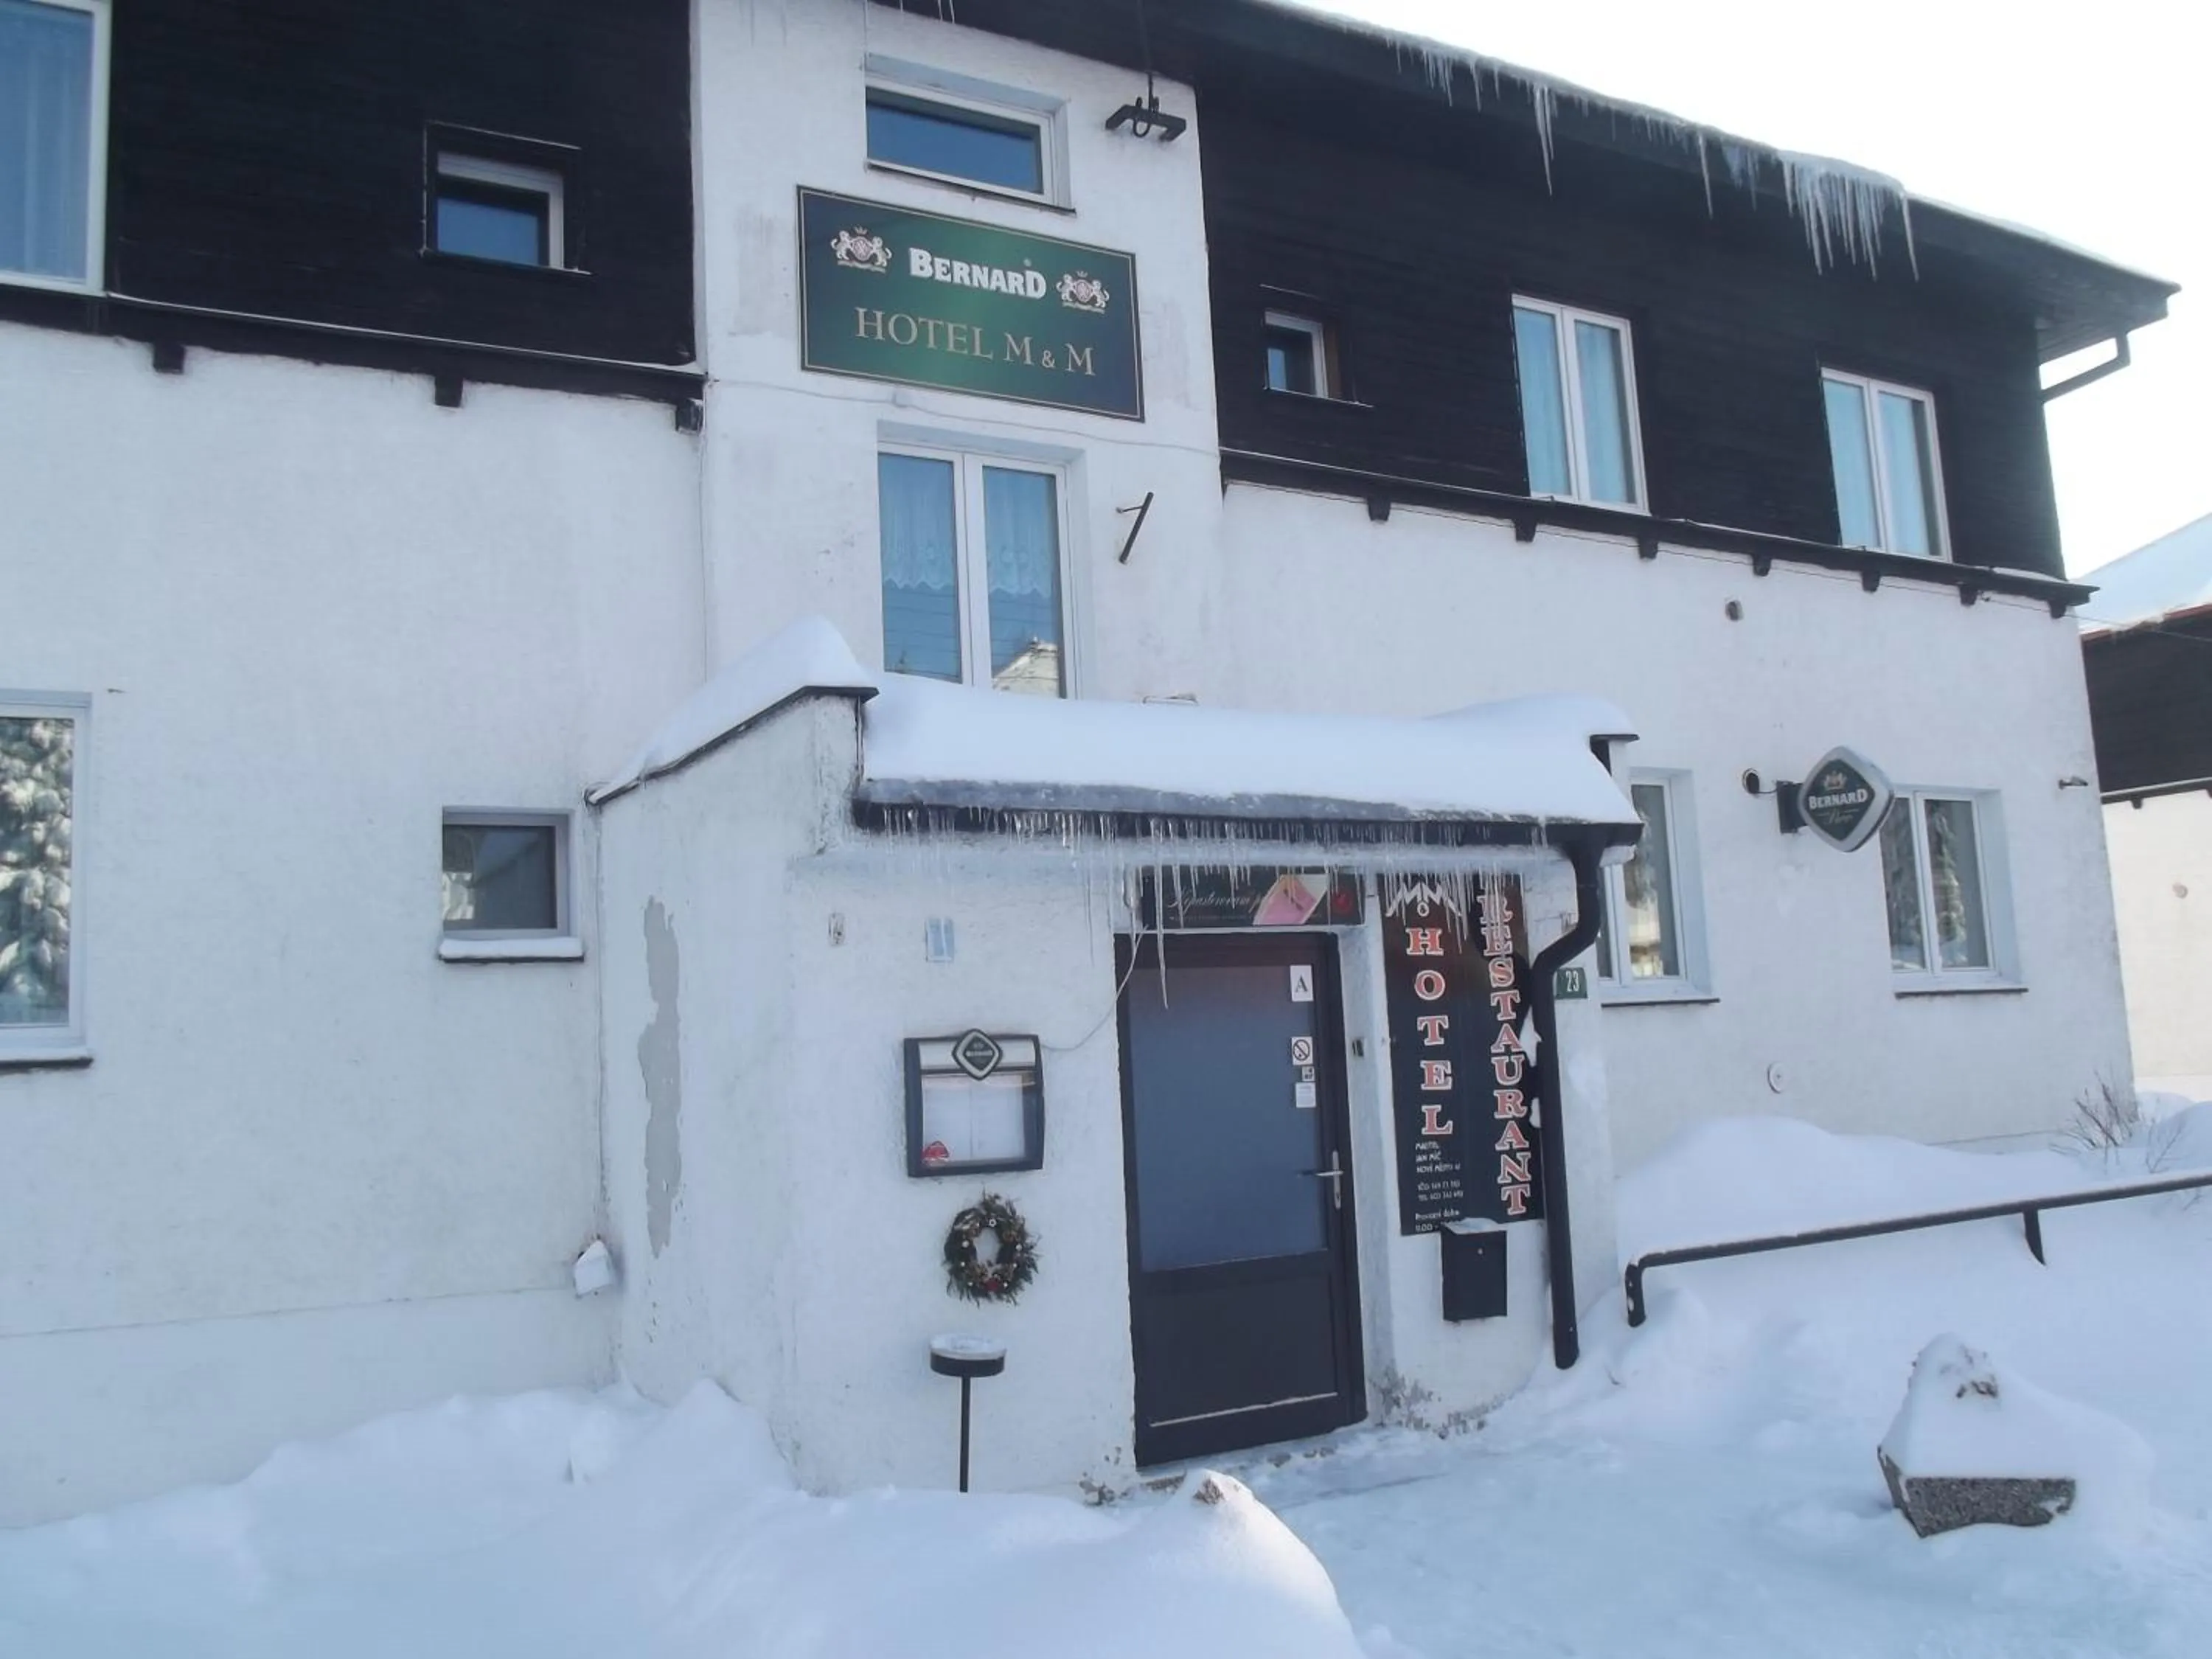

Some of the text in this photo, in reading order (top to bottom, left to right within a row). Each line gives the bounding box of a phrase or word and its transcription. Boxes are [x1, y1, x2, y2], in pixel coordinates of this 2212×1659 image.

[908, 247, 1046, 299] BERNARD
[855, 307, 1096, 377] HOTEL M & M
[1808, 788, 1868, 810] BERNARD
[1294, 975, 1308, 993] A
[1565, 970, 1580, 992] 23
[1405, 928, 1453, 1135] HOTEL
[1476, 894, 1531, 1216] RESTAURANT
